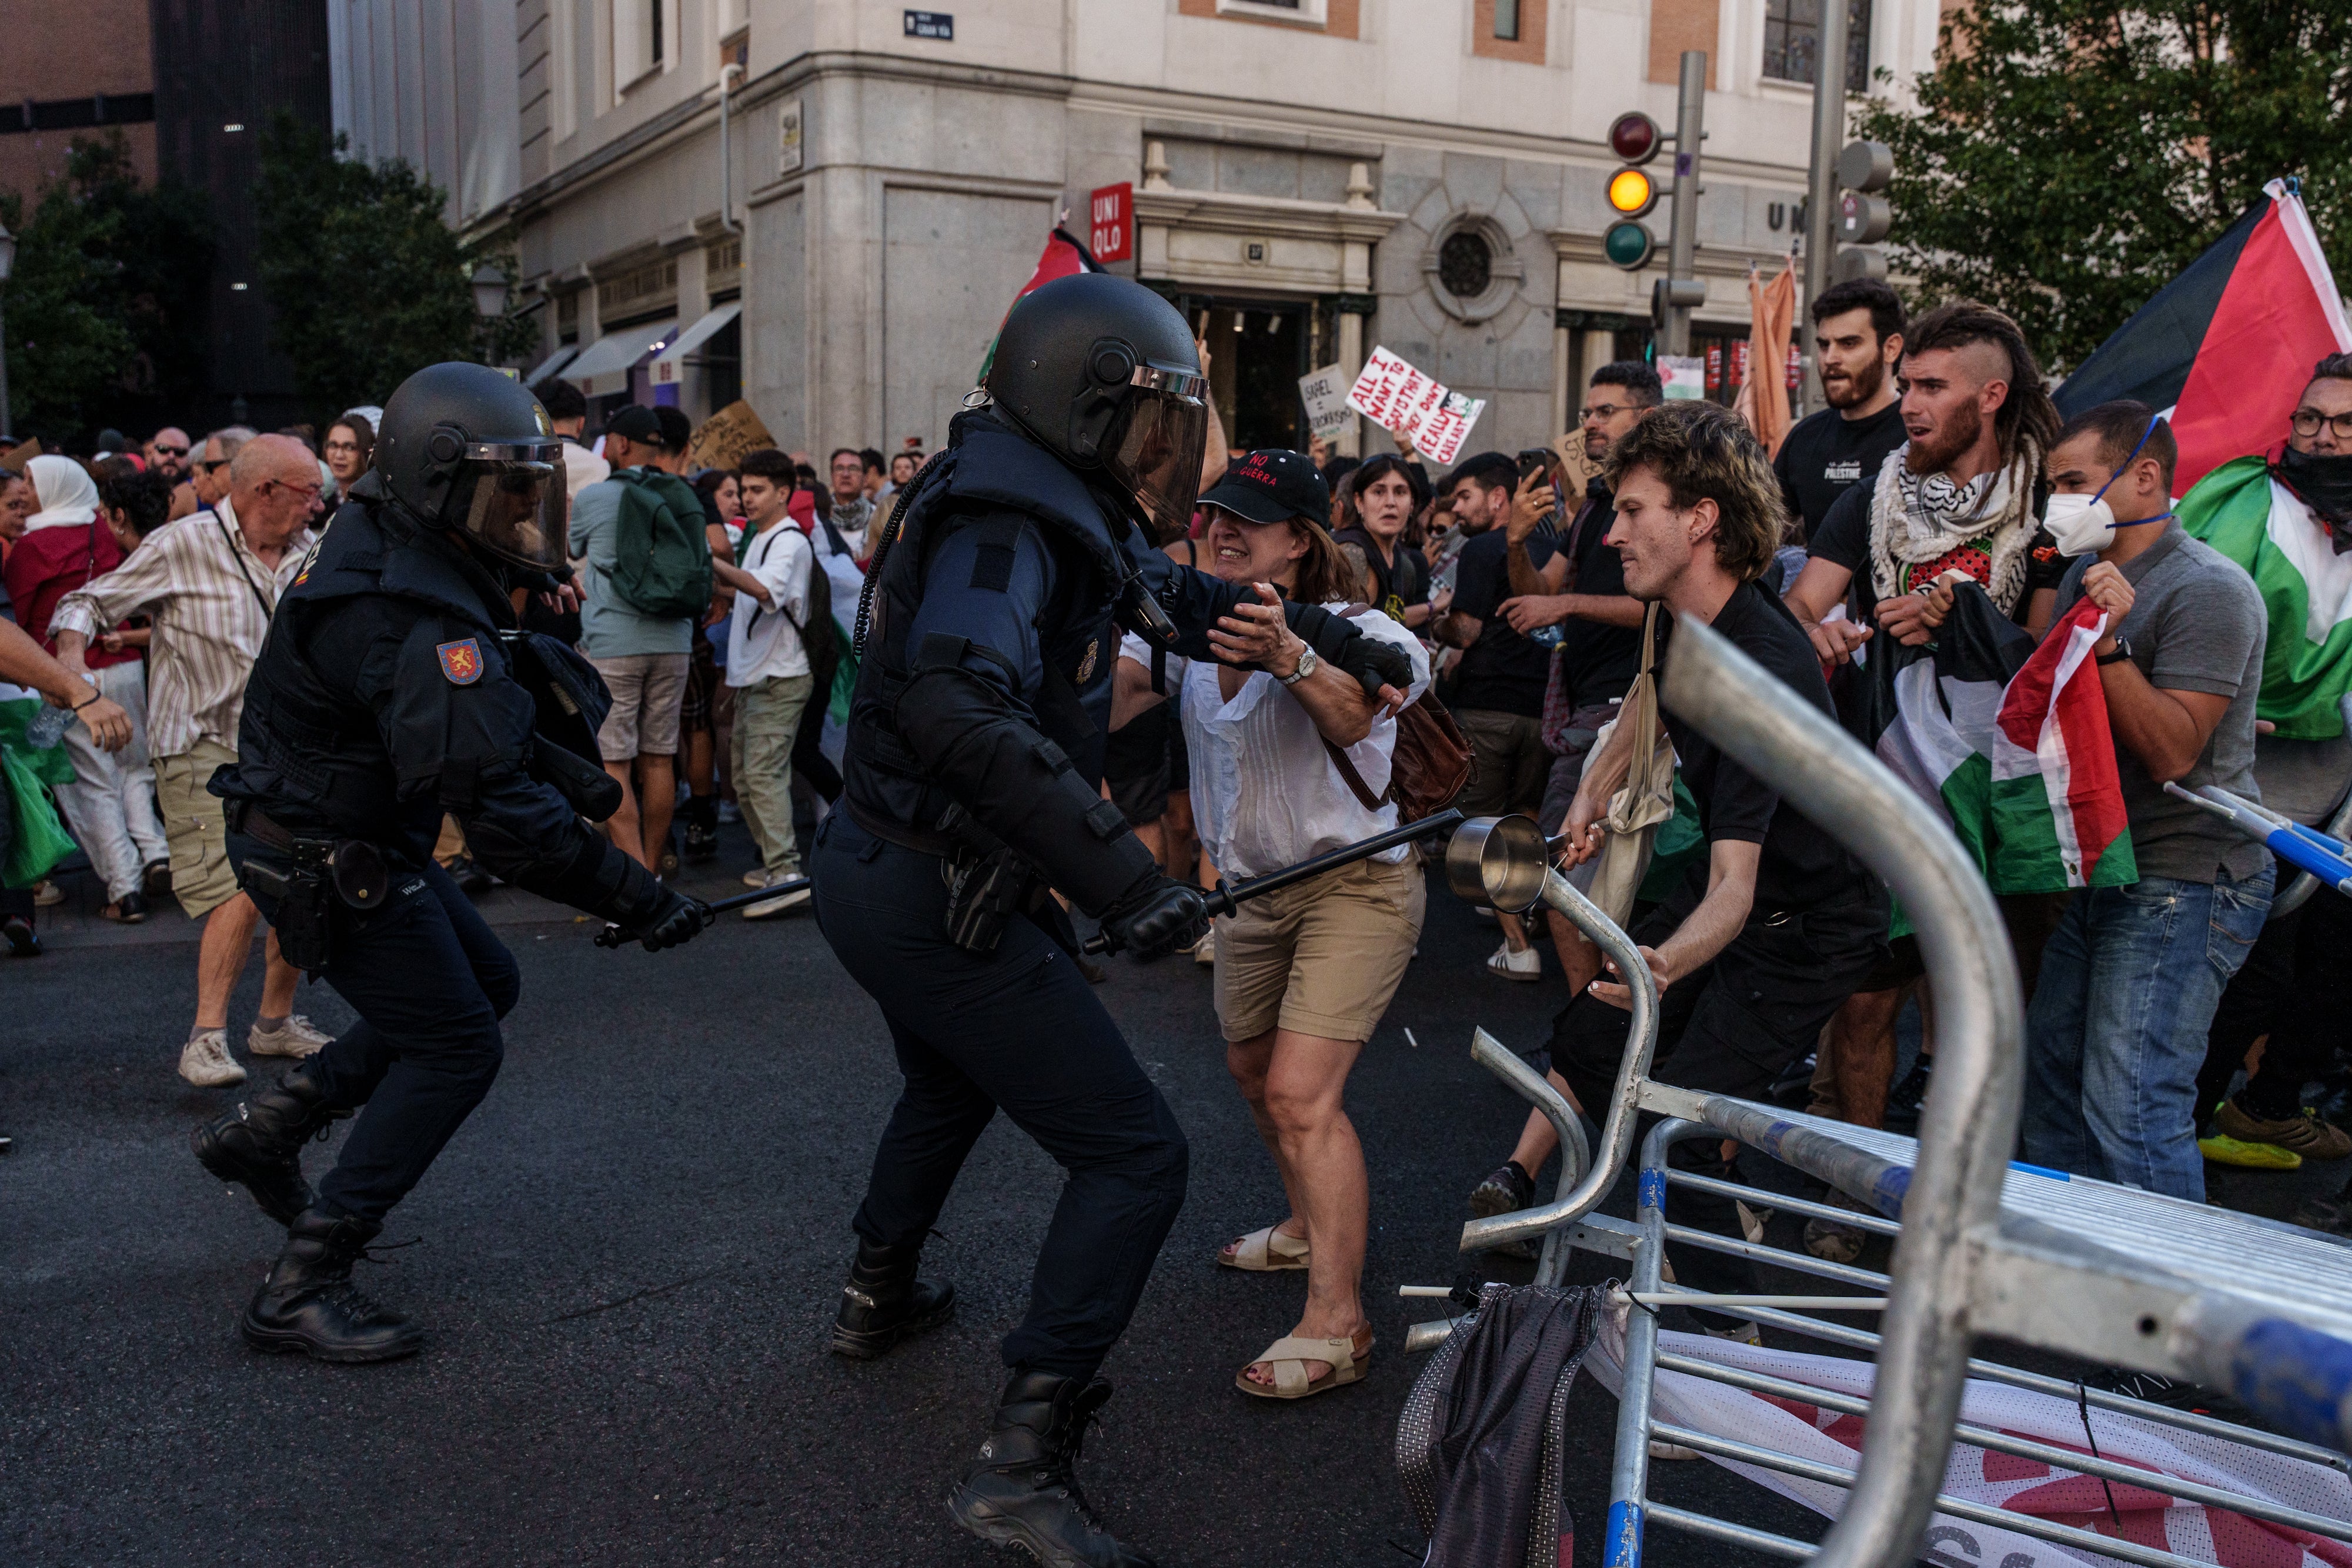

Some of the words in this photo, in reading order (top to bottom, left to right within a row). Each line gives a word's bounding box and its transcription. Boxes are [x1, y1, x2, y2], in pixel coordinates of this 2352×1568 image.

[1094, 193, 1120, 223] UNI
[1094, 225, 1121, 259] QLO
[1352, 377, 1377, 407] ALL
[1371, 356, 1388, 371] I
[1367, 376, 1395, 418] WANT
[1389, 362, 1404, 375] TO
[1399, 370, 1422, 400] THAT
[1416, 413, 1450, 456] REALLY
[1250, 453, 1268, 466] NO
[1240, 466, 1277, 487] GUERRA
